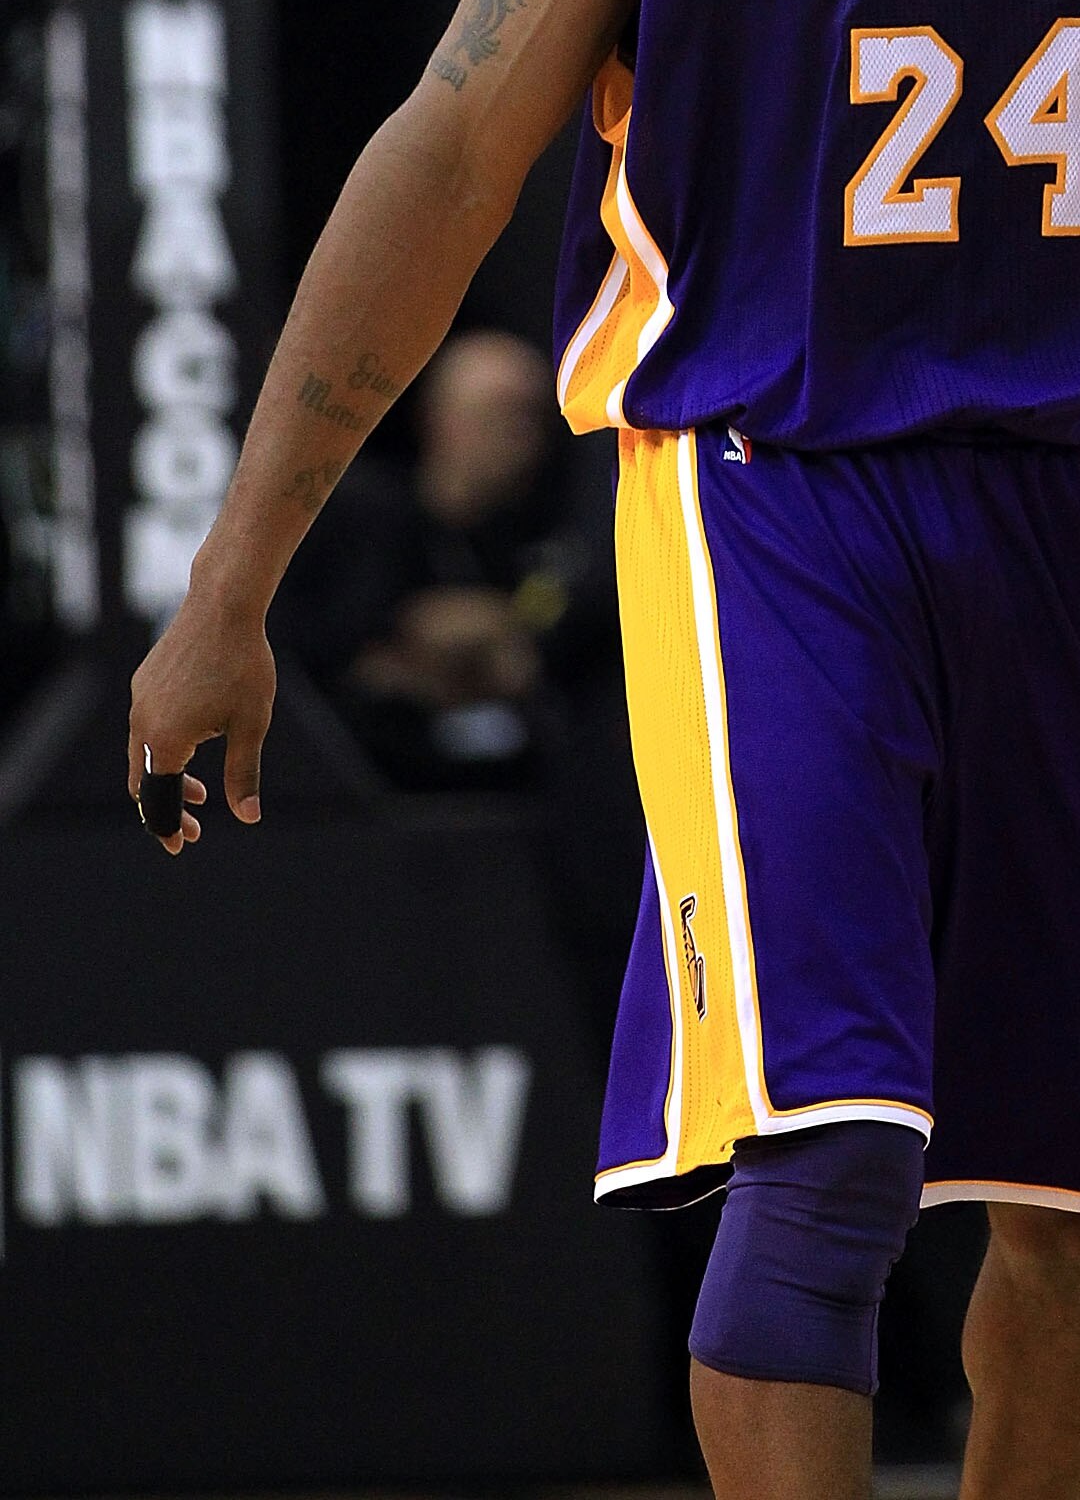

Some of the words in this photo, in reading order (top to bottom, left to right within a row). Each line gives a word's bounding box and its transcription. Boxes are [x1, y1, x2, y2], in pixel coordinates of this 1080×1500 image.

[723, 450, 742, 462] NBA
[12, 1050, 328, 1228] NBA
[318, 1044, 534, 1220] TV
